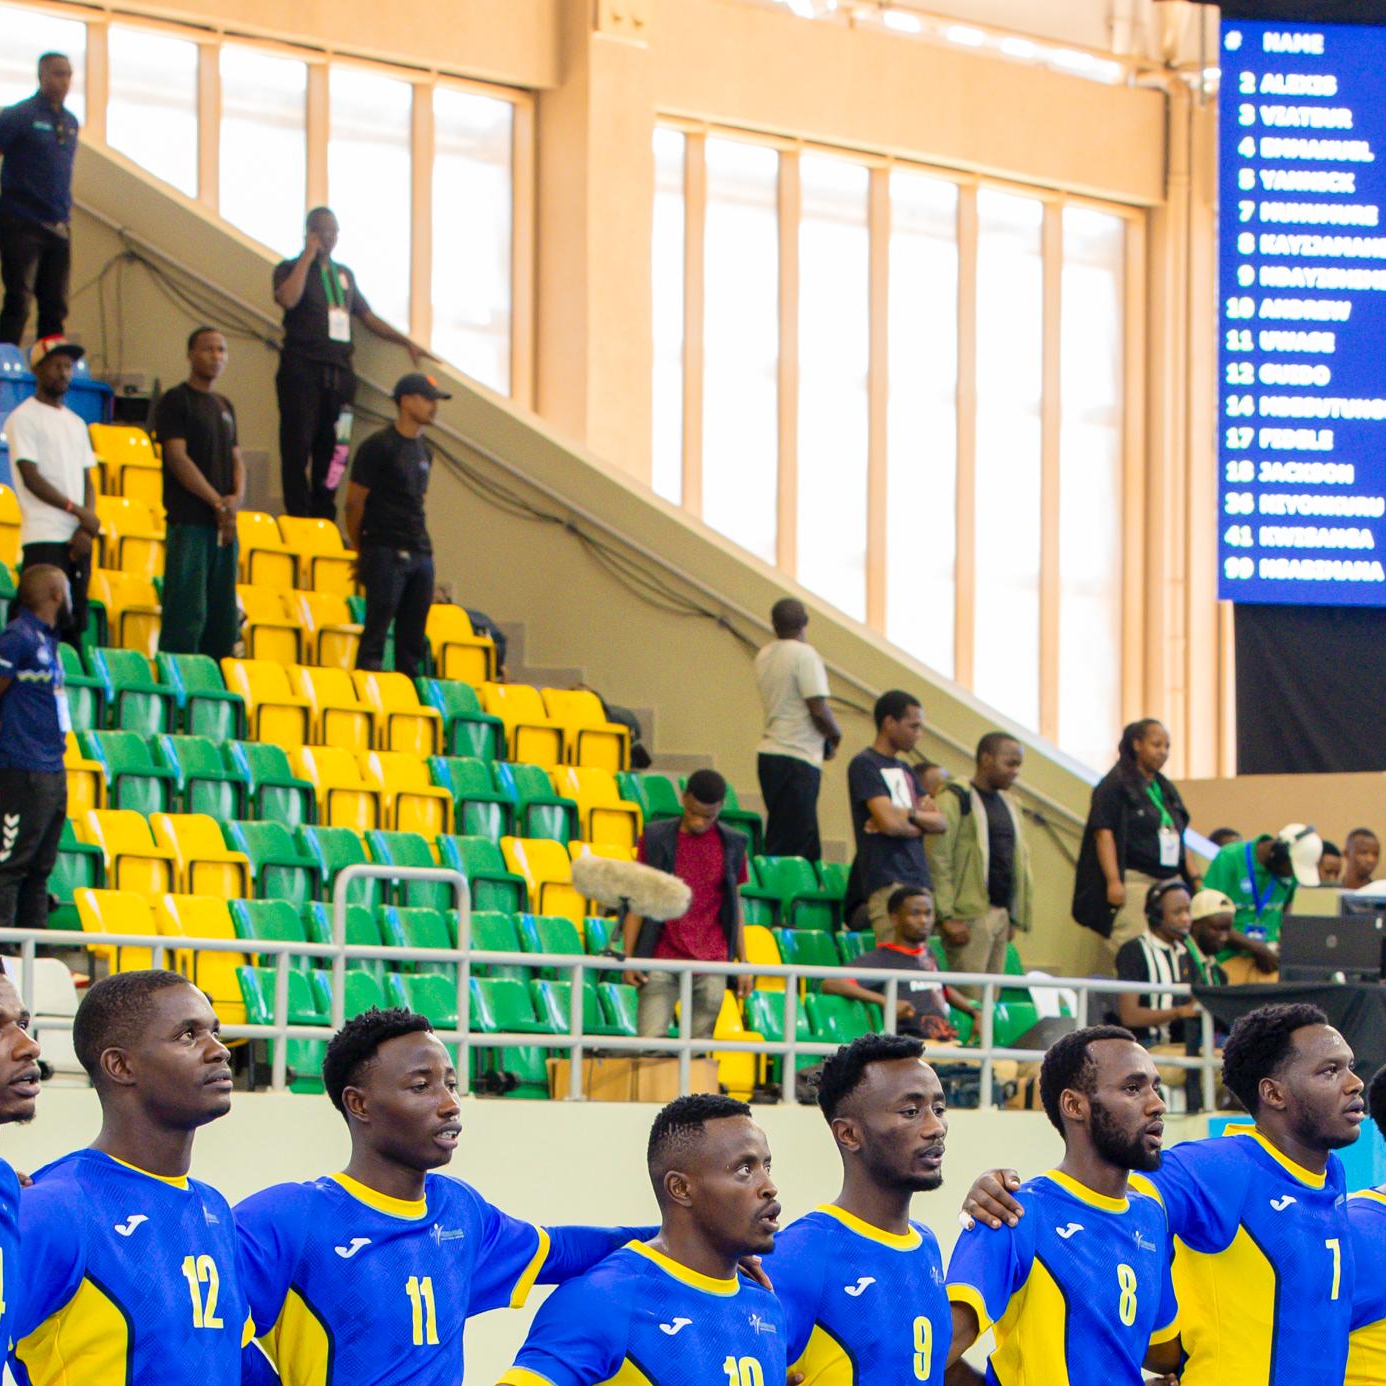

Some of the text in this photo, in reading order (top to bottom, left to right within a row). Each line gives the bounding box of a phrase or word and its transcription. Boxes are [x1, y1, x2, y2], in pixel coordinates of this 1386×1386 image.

[1263, 32, 1324, 54] NAME
[1240, 71, 1256, 93] 2
[1238, 136, 1256, 157] 4
[1239, 168, 1256, 189] 5
[1239, 200, 1256, 222] 7
[1226, 296, 1255, 318] 10
[1227, 329, 1254, 351] 11
[1226, 362, 1255, 384] 12
[1226, 394, 1255, 416] 14
[1226, 426, 1255, 449] 17
[1224, 525, 1254, 547] 41
[181, 1254, 224, 1329] 12
[1117, 1263, 1138, 1327] 8
[405, 1275, 440, 1346] 11
[913, 1315, 933, 1381] 9
